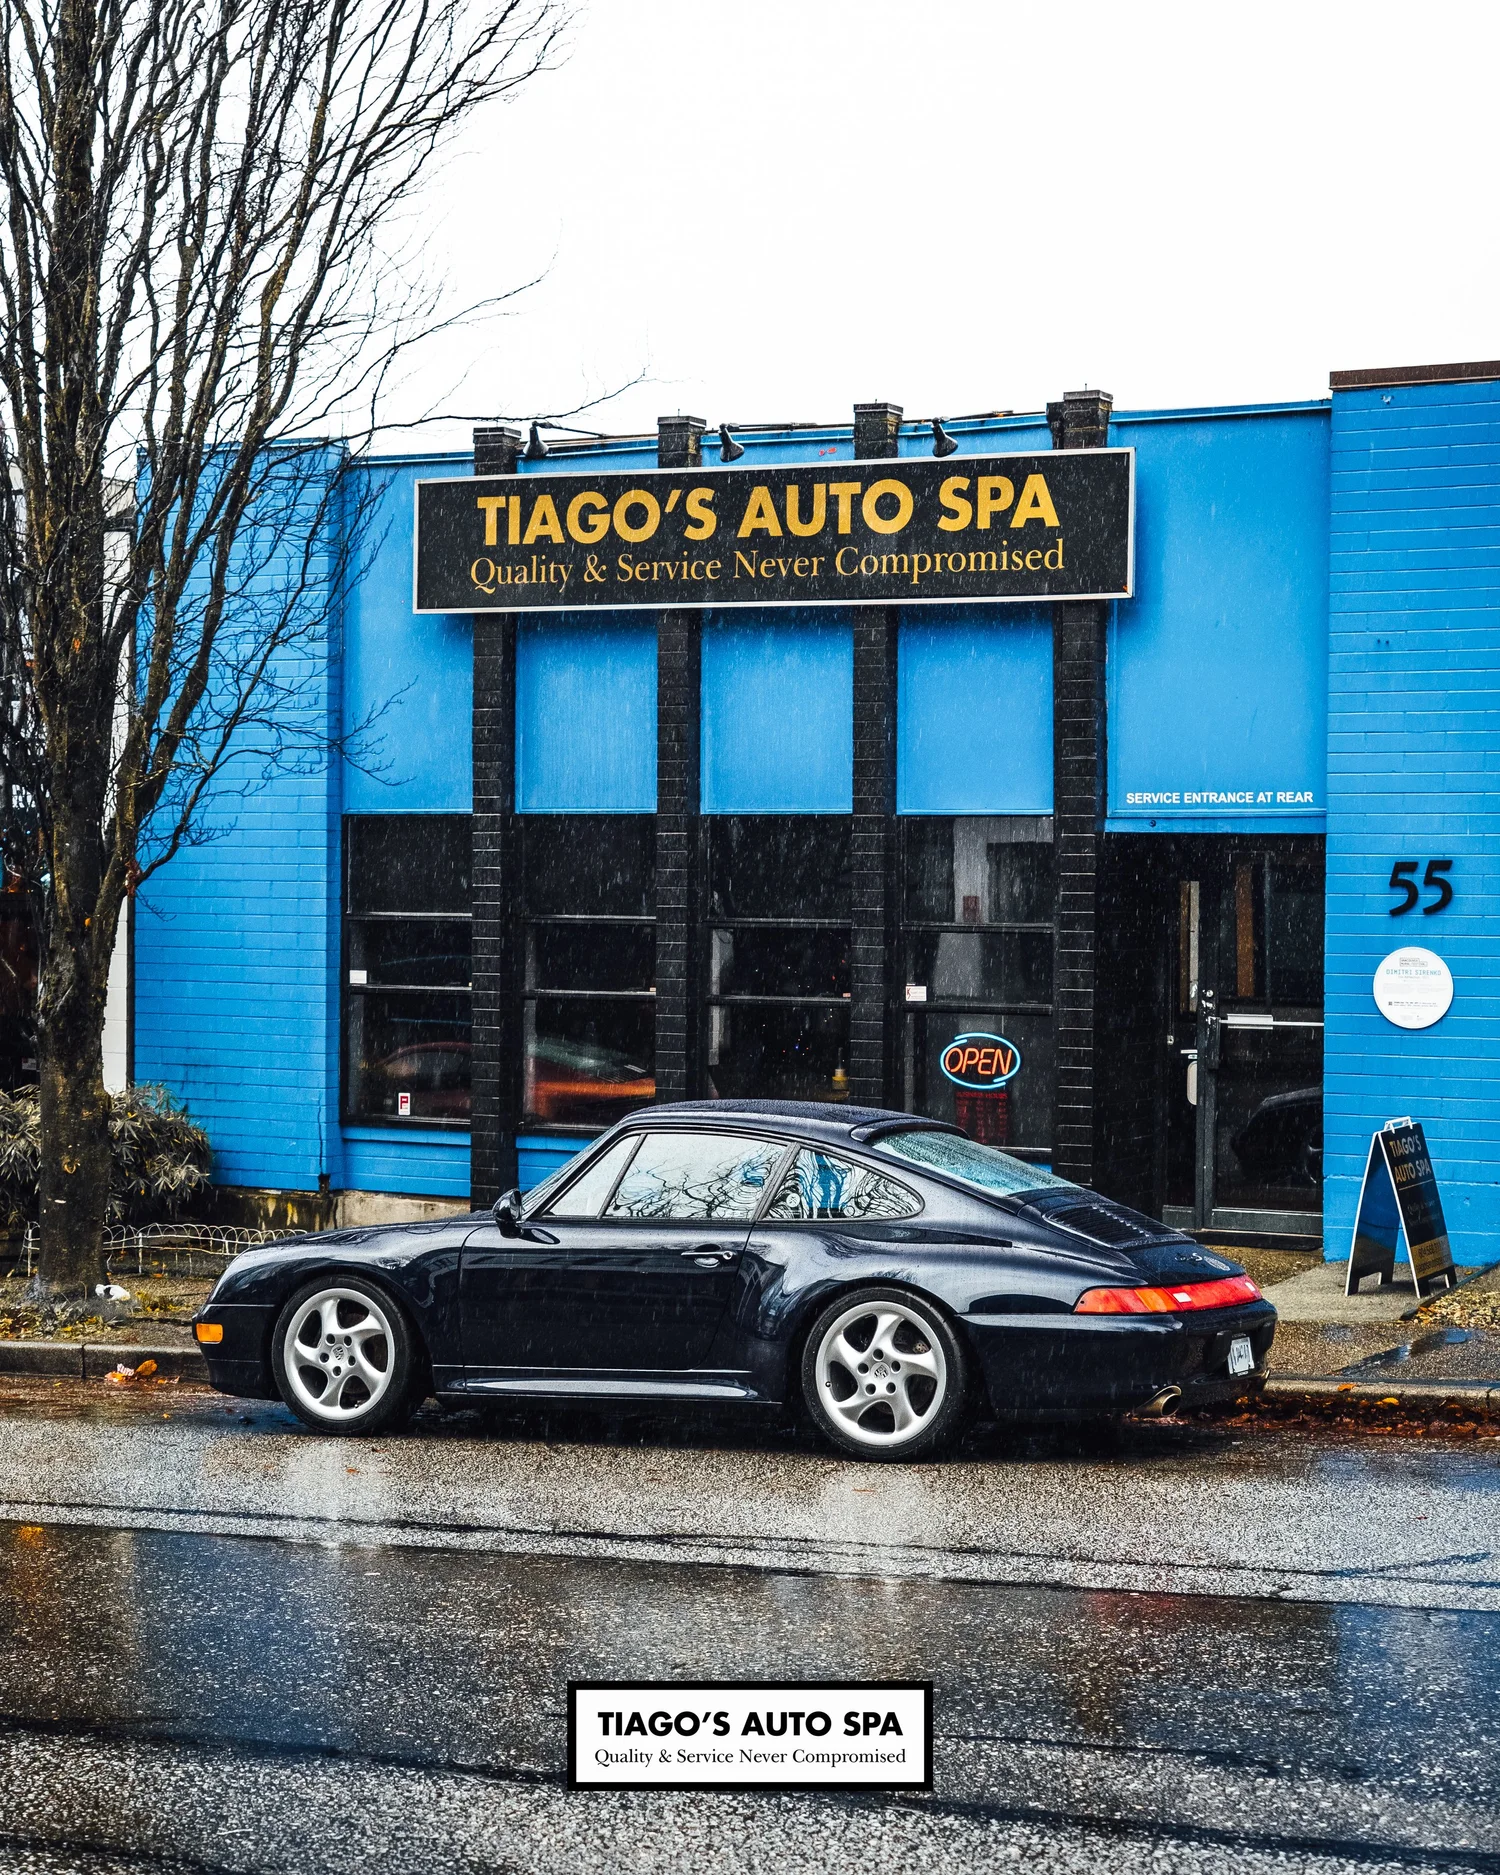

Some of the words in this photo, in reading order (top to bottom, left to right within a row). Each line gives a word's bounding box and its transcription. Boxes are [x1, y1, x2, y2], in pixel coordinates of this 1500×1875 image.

[476, 487, 717, 546] TIAGO'S
[737, 478, 914, 538] AUTO
[937, 473, 1061, 532] SPA
[470, 555, 573, 594] Quality
[583, 554, 607, 583] &
[616, 551, 721, 582] Service
[733, 550, 825, 578] Never
[835, 538, 1065, 585] Compromised
[1126, 792, 1180, 804] SERVICE
[1184, 791, 1254, 804] ENTRANCE
[1256, 791, 1274, 803] AT
[1276, 791, 1314, 803] REAR
[1389, 860, 1453, 916] 55
[945, 1047, 1012, 1075] OPEN
[1389, 1134, 1422, 1158] TIAGO'S
[1394, 1162, 1416, 1183] AUTO
[1416, 1158, 1431, 1177] SPA
